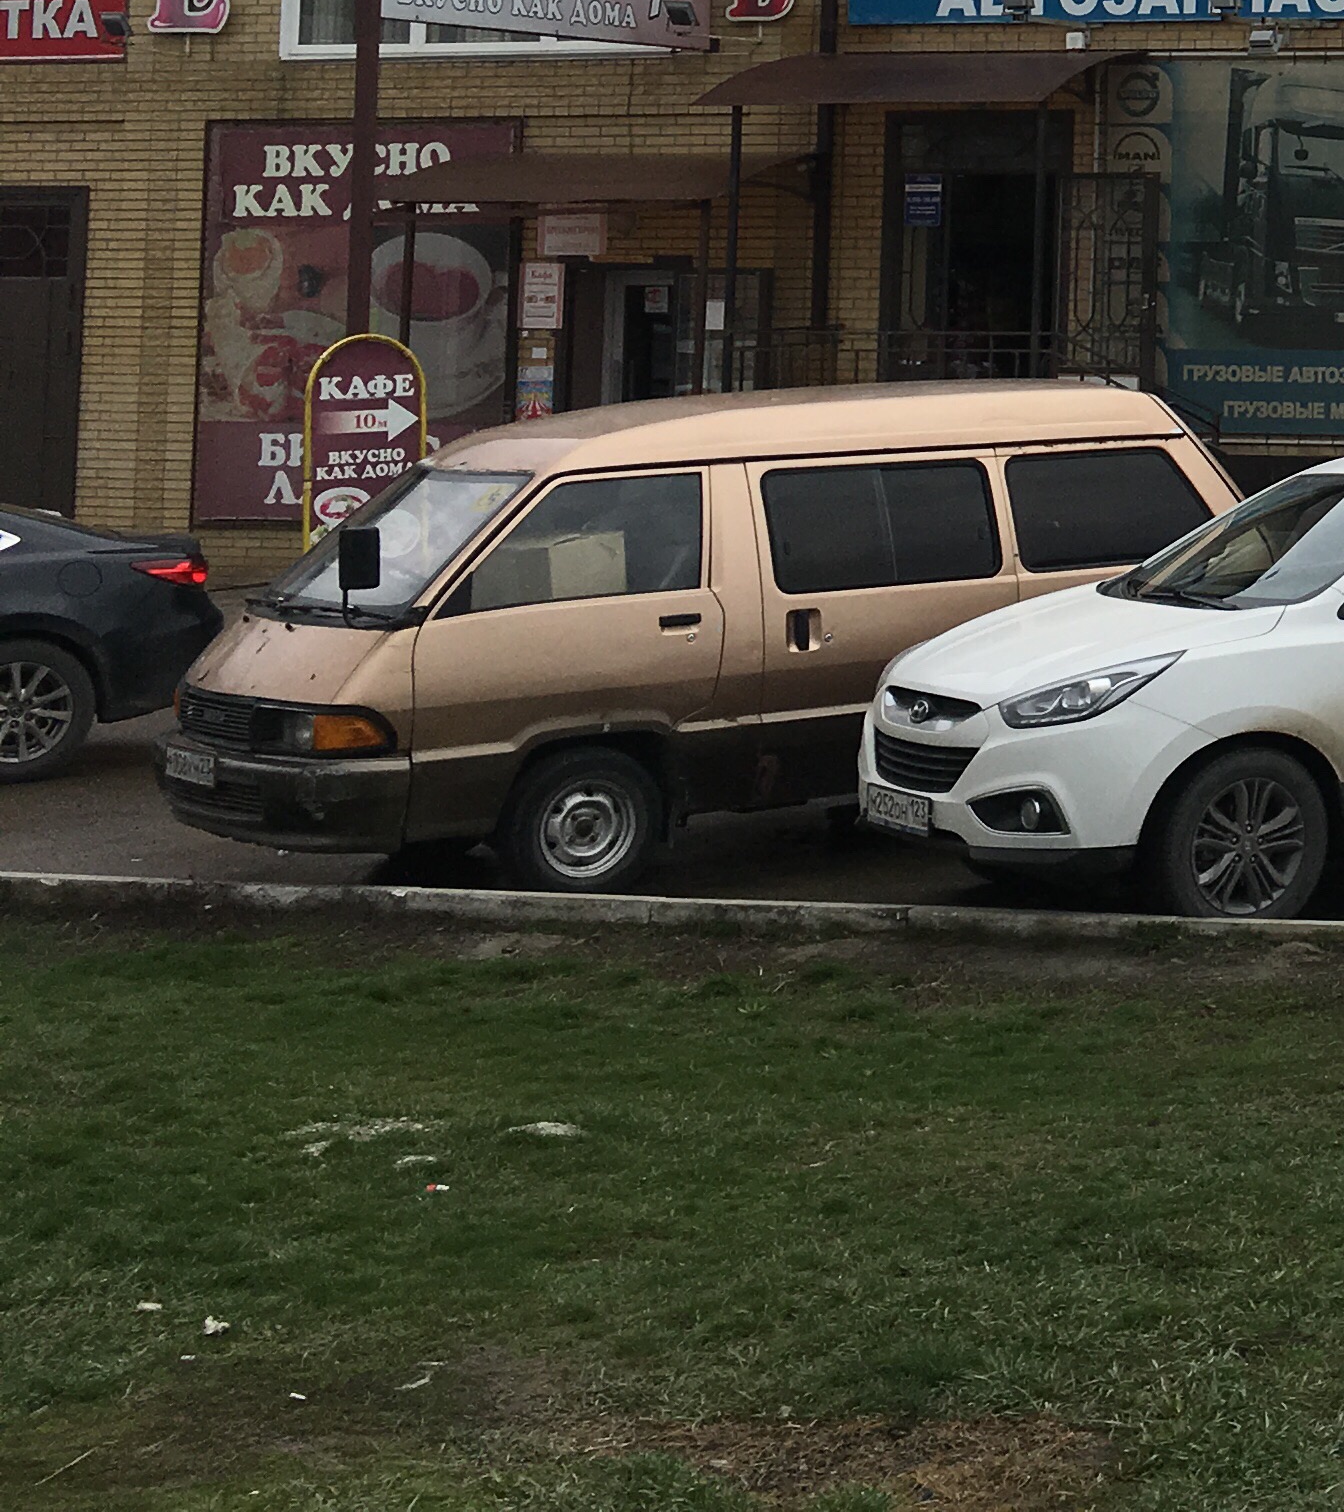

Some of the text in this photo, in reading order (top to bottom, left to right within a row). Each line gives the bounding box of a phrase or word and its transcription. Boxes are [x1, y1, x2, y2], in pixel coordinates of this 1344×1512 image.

[1116, 152, 1160, 161] MAN
[232, 183, 332, 217] КАК
[1182, 365, 1284, 384] ГРУЗОВЫЕ
[318, 374, 415, 401] КАФЕ
[1222, 399, 1327, 420] ГРУЗОВЫЕ
[328, 448, 406, 465] ВКУСНО
[315, 465, 359, 481] КАК
